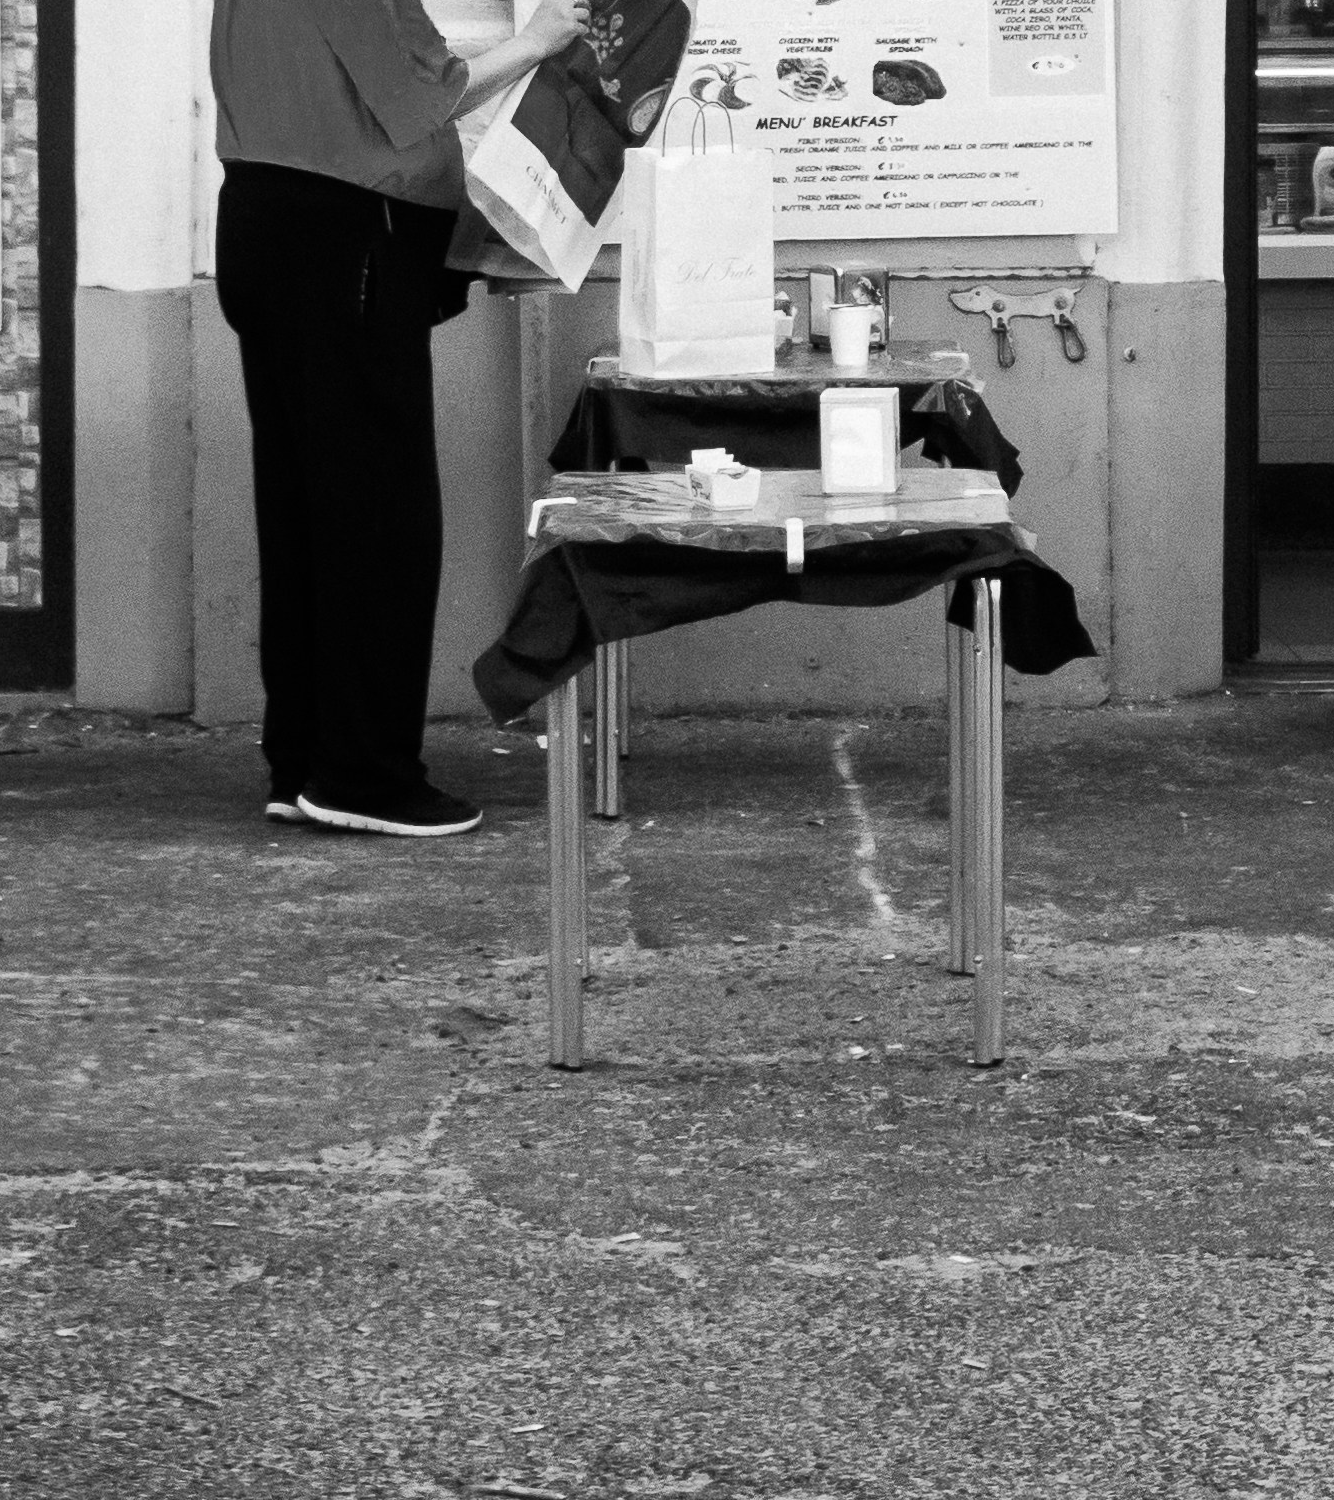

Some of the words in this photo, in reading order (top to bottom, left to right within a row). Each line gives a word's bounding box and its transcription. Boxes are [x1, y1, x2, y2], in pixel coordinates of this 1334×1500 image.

[817, 37, 839, 45] WITH
[914, 37, 937, 45] WITH
[813, 115, 898, 129] BREAKFAST
